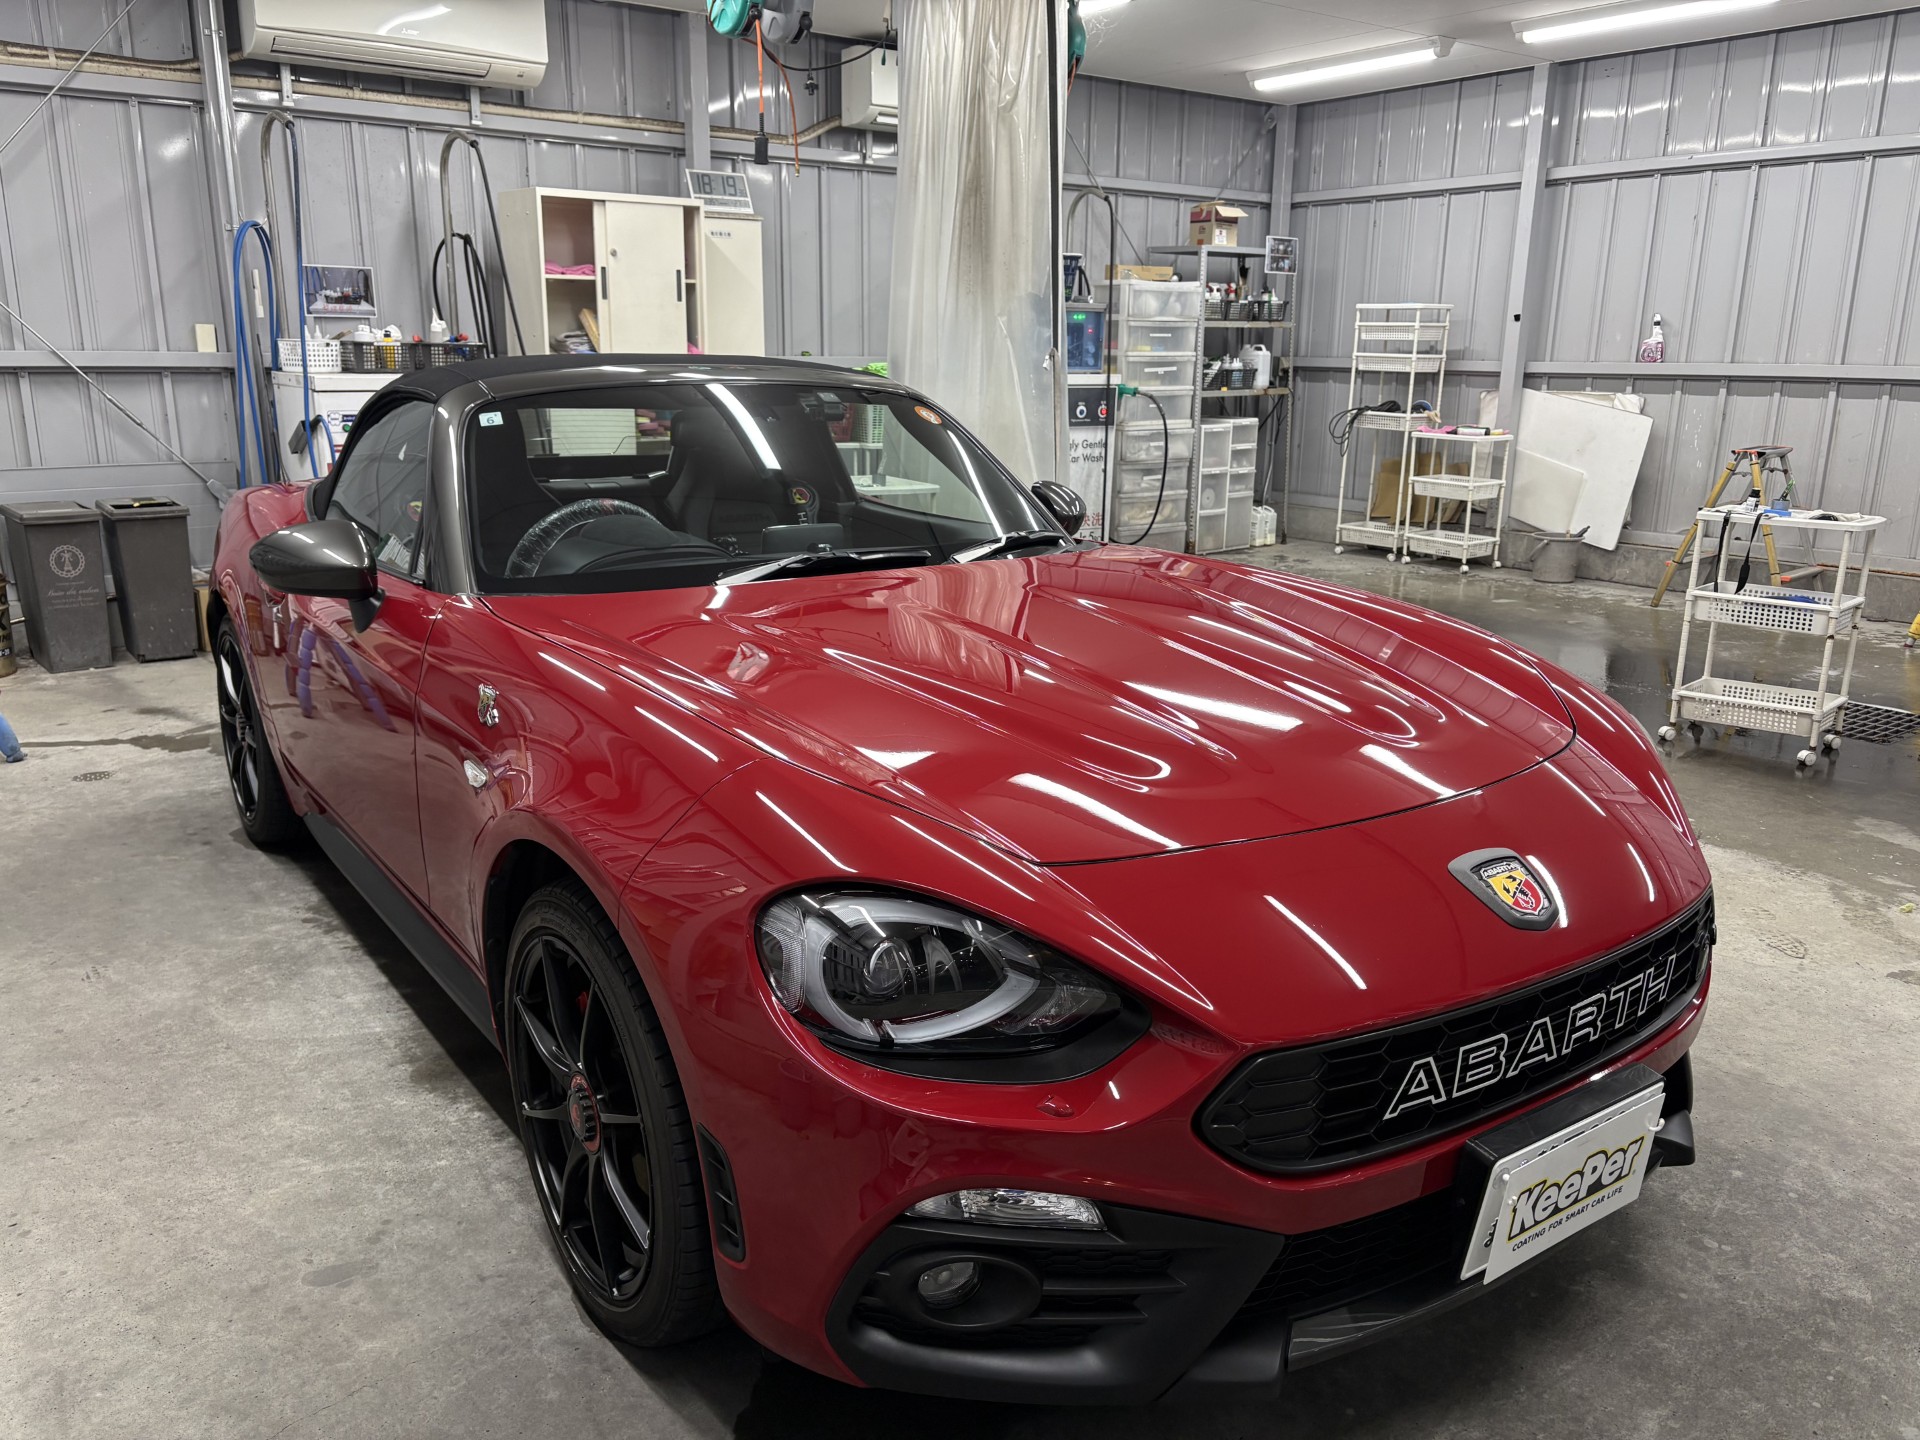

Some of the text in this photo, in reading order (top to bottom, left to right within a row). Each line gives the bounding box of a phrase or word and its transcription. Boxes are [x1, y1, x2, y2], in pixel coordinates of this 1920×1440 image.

[696, 174, 738, 196] 18:19
[1081, 452, 1104, 463] Wash
[1483, 862, 1521, 877] ABARTH
[1382, 953, 1677, 1120] ABARTH
[1506, 1136, 1646, 1241] KeePer
[1512, 1228, 1546, 1252] COATING
[1548, 1218, 1563, 1232] FOR
[1565, 1203, 1590, 1222] SMART
[1591, 1196, 1606, 1208] CAR
[1606, 1185, 1624, 1200] LIFE
